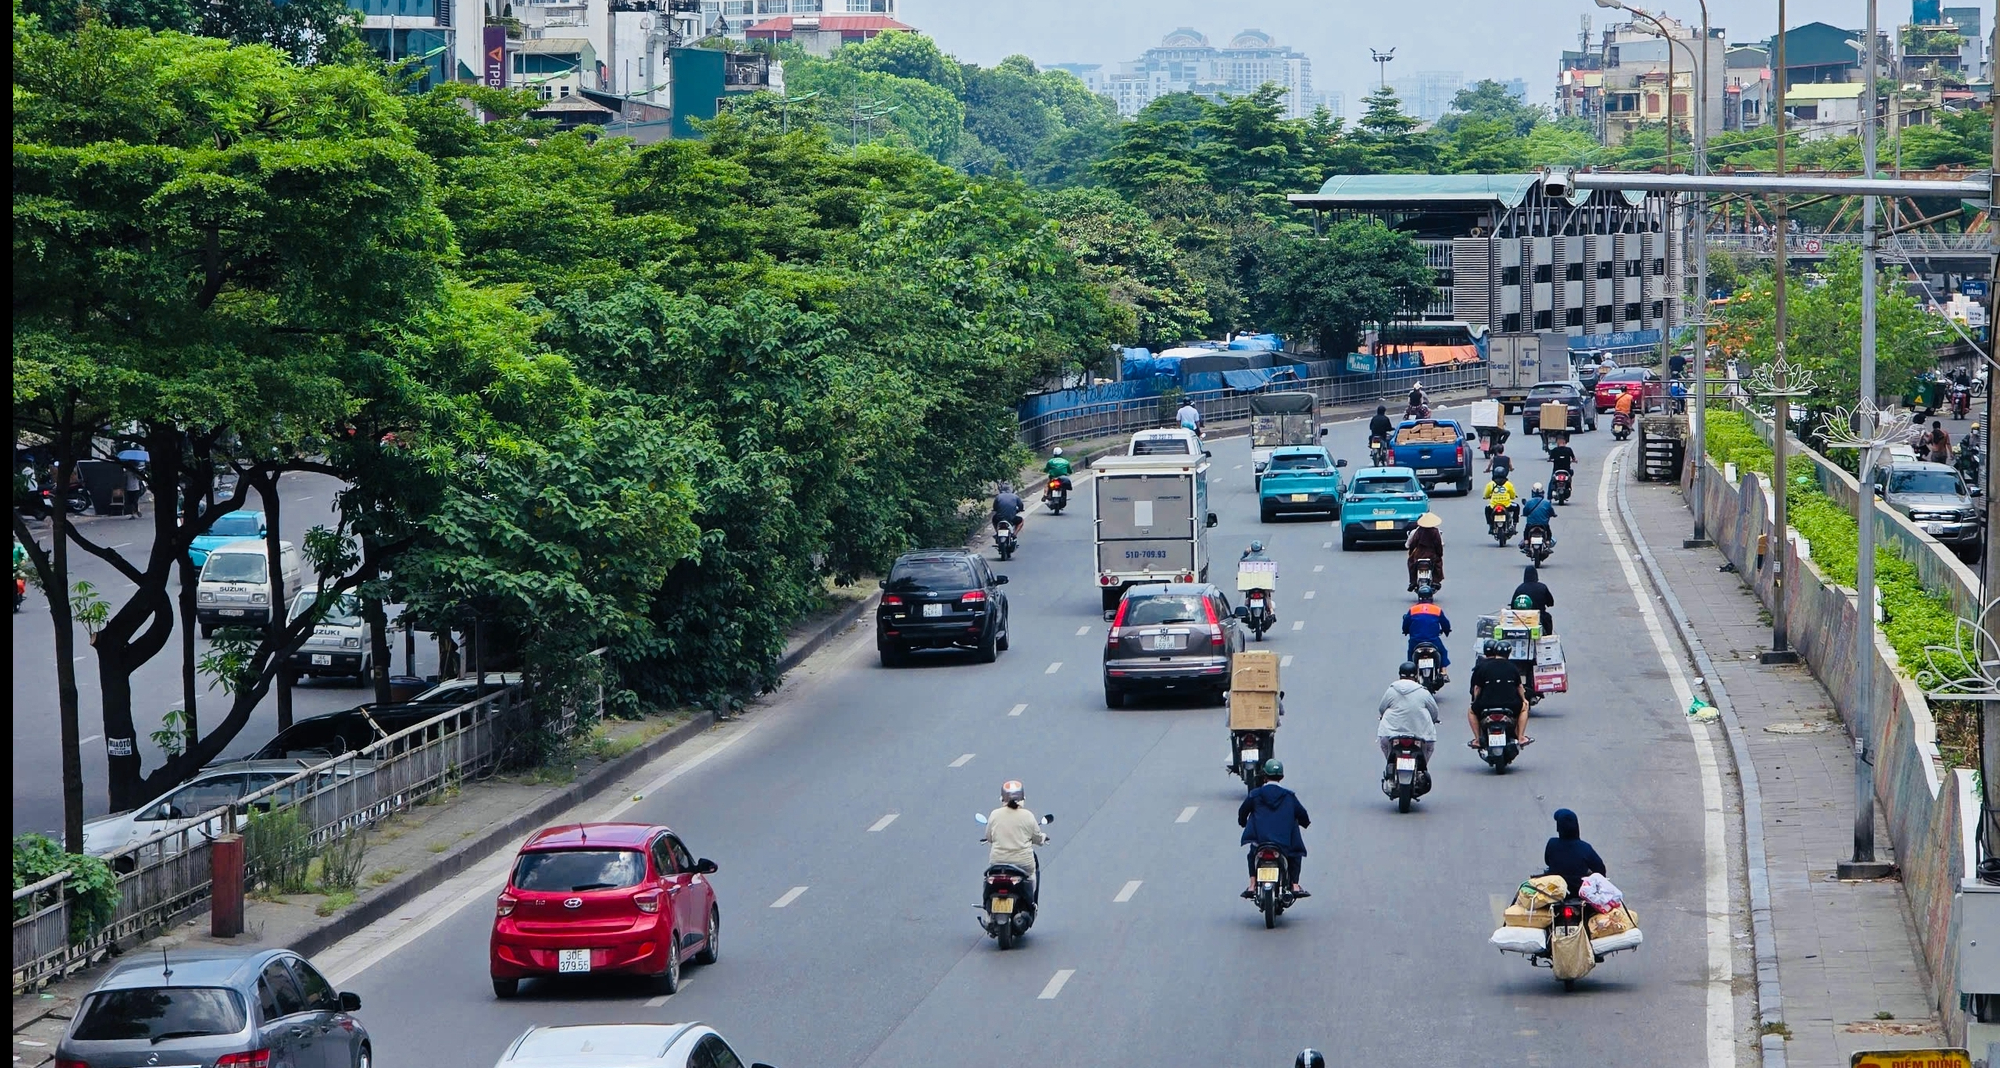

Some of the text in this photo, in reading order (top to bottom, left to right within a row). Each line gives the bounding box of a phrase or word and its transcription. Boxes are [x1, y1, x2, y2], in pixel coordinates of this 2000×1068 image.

[1125, 550, 1167, 559] 51D-709.93
[566, 950, 583, 960] 30E
[560, 960, 589, 972] 379.55
